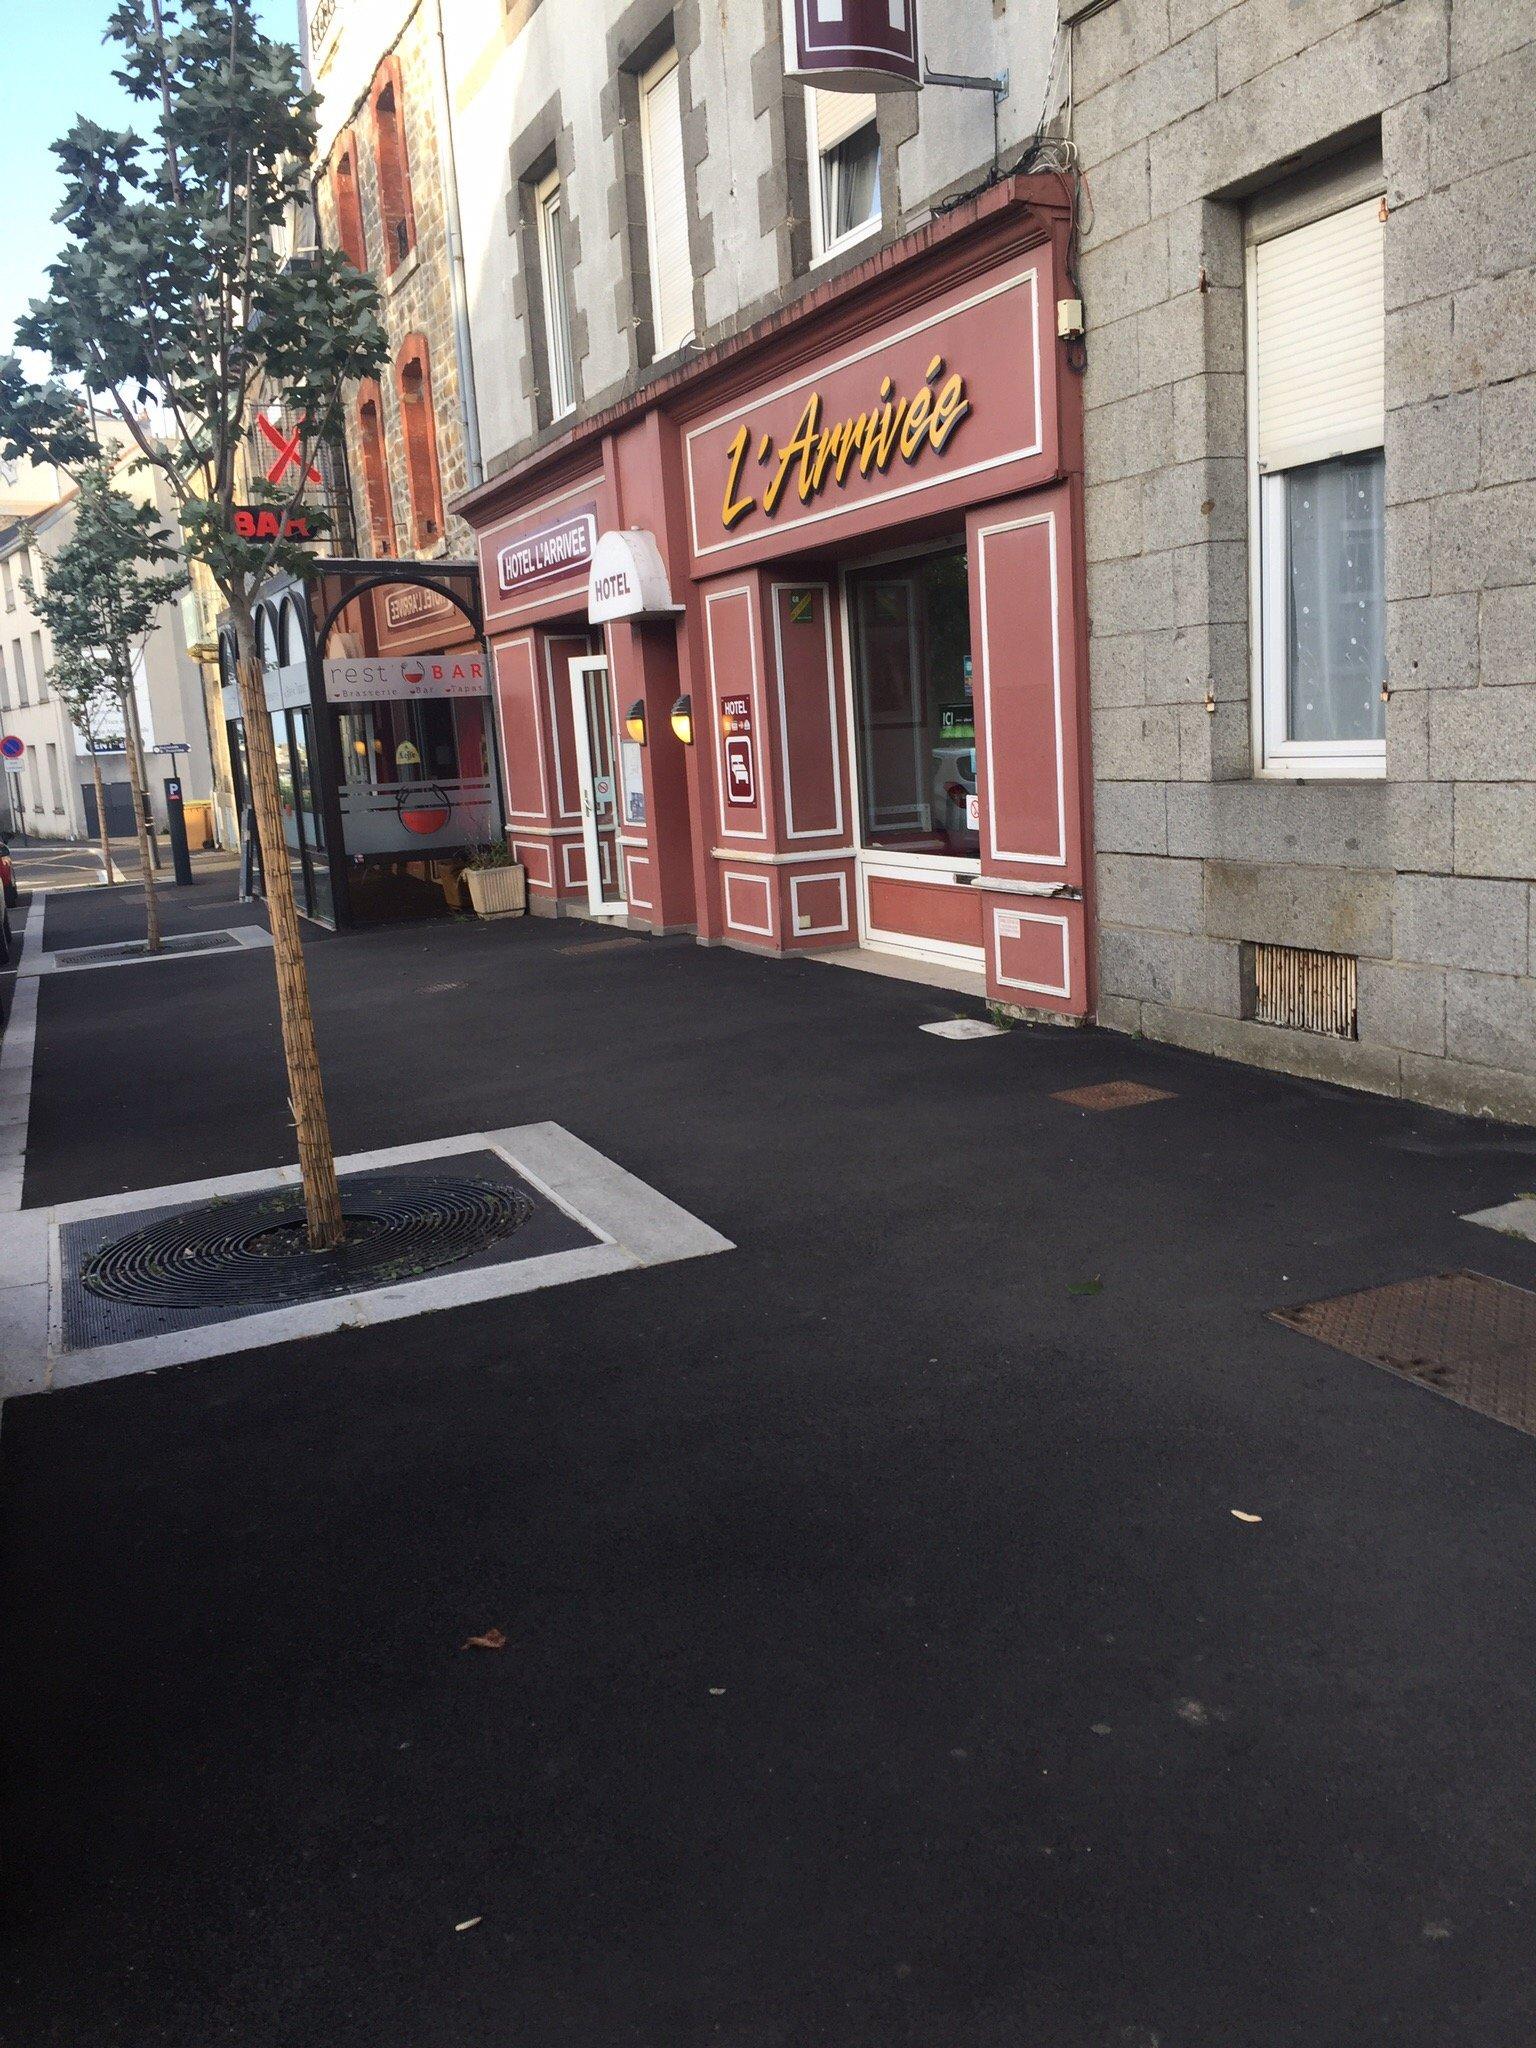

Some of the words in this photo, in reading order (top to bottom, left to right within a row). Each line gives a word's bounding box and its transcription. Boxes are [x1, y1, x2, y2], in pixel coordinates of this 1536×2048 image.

[505, 548, 536, 581] HOTEL
[535, 526, 587, 570] L'ARRIVEE
[594, 572, 631, 602] HOTEL
[431, 663, 483, 680] BAR
[724, 700, 748, 715] HOTEL
